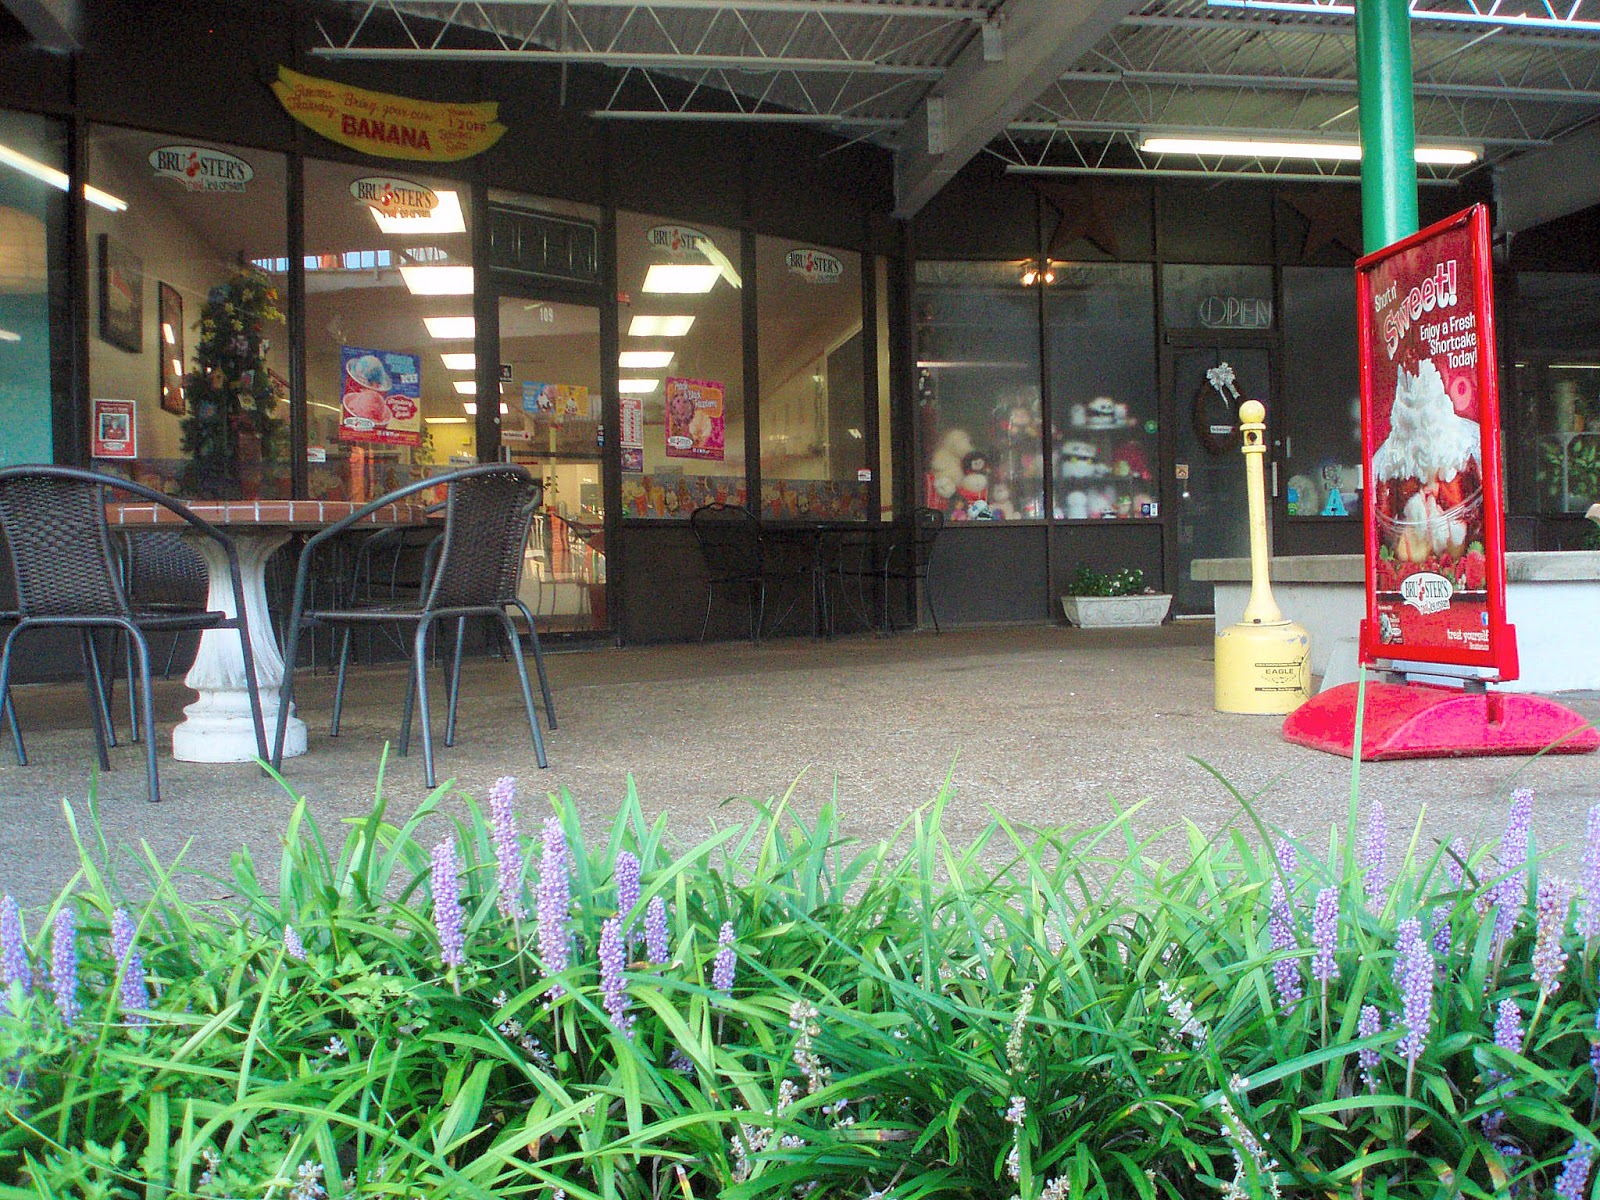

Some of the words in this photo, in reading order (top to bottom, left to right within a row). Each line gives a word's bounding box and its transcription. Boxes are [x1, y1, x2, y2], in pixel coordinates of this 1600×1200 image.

[341, 113, 431, 151] BANANA
[1200, 296, 1272, 327] OPEN
[1374, 287, 1391, 313] Short
[1383, 260, 1458, 360] Sweet!
[540, 306, 554, 322] 109
[1420, 323, 1440, 343] Enjoy
[1442, 321, 1449, 335] a
[1450, 311, 1476, 333] Fresh
[1430, 331, 1476, 356] Shortcake
[1447, 347, 1477, 369] Today!
[1447, 629, 1462, 641] treat
[1463, 629, 1489, 643] yourself
